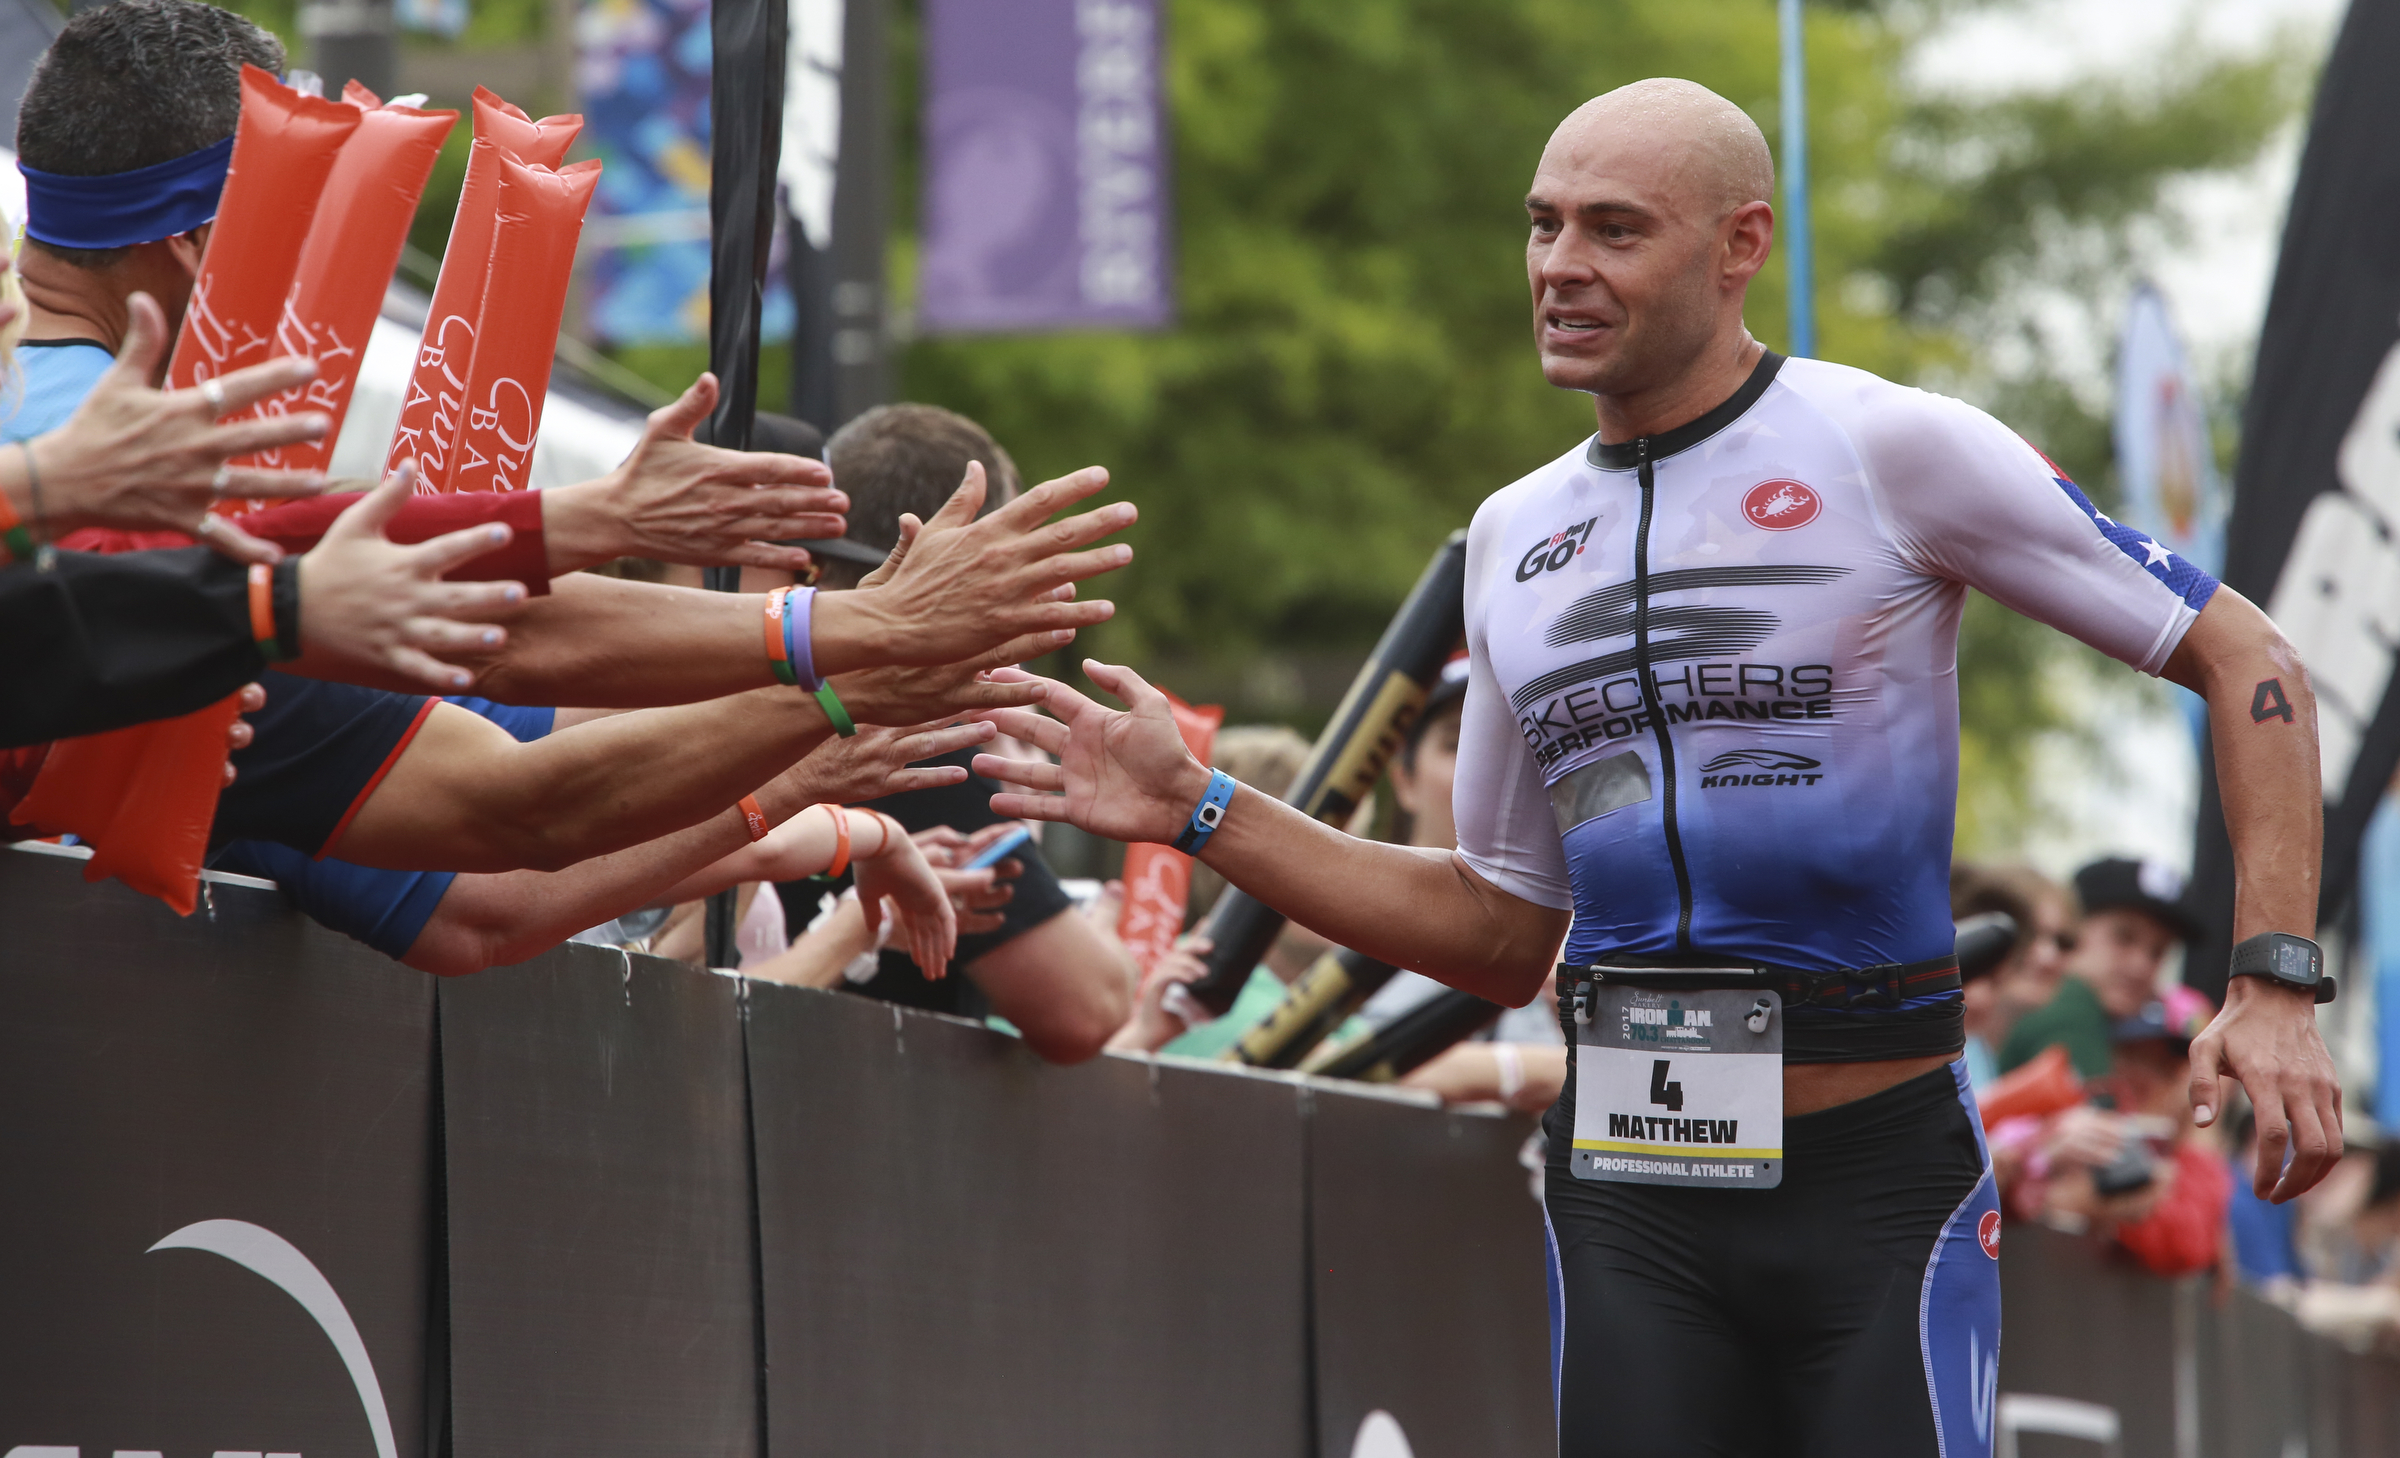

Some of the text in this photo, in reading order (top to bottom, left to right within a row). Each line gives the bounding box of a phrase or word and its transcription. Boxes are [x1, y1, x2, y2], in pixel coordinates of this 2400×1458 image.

[1516, 516, 1598, 583] GO!
[1520, 664, 1834, 749] SKECHERS
[2249, 677, 2296, 725] 4
[1534, 699, 1834, 769] PERFORMANCE
[1701, 774, 1824, 789] KNIGHT
[1622, 1006, 1631, 1040] 2017
[1630, 1003, 1711, 1027] IRONMAN
[1630, 1024, 1659, 1042] 70.3
[1650, 1059, 1684, 1112] 4
[1608, 1113, 1738, 1144] MATTHEW
[1593, 1156, 1755, 1179] PROFESSIONAL ATHLETE
